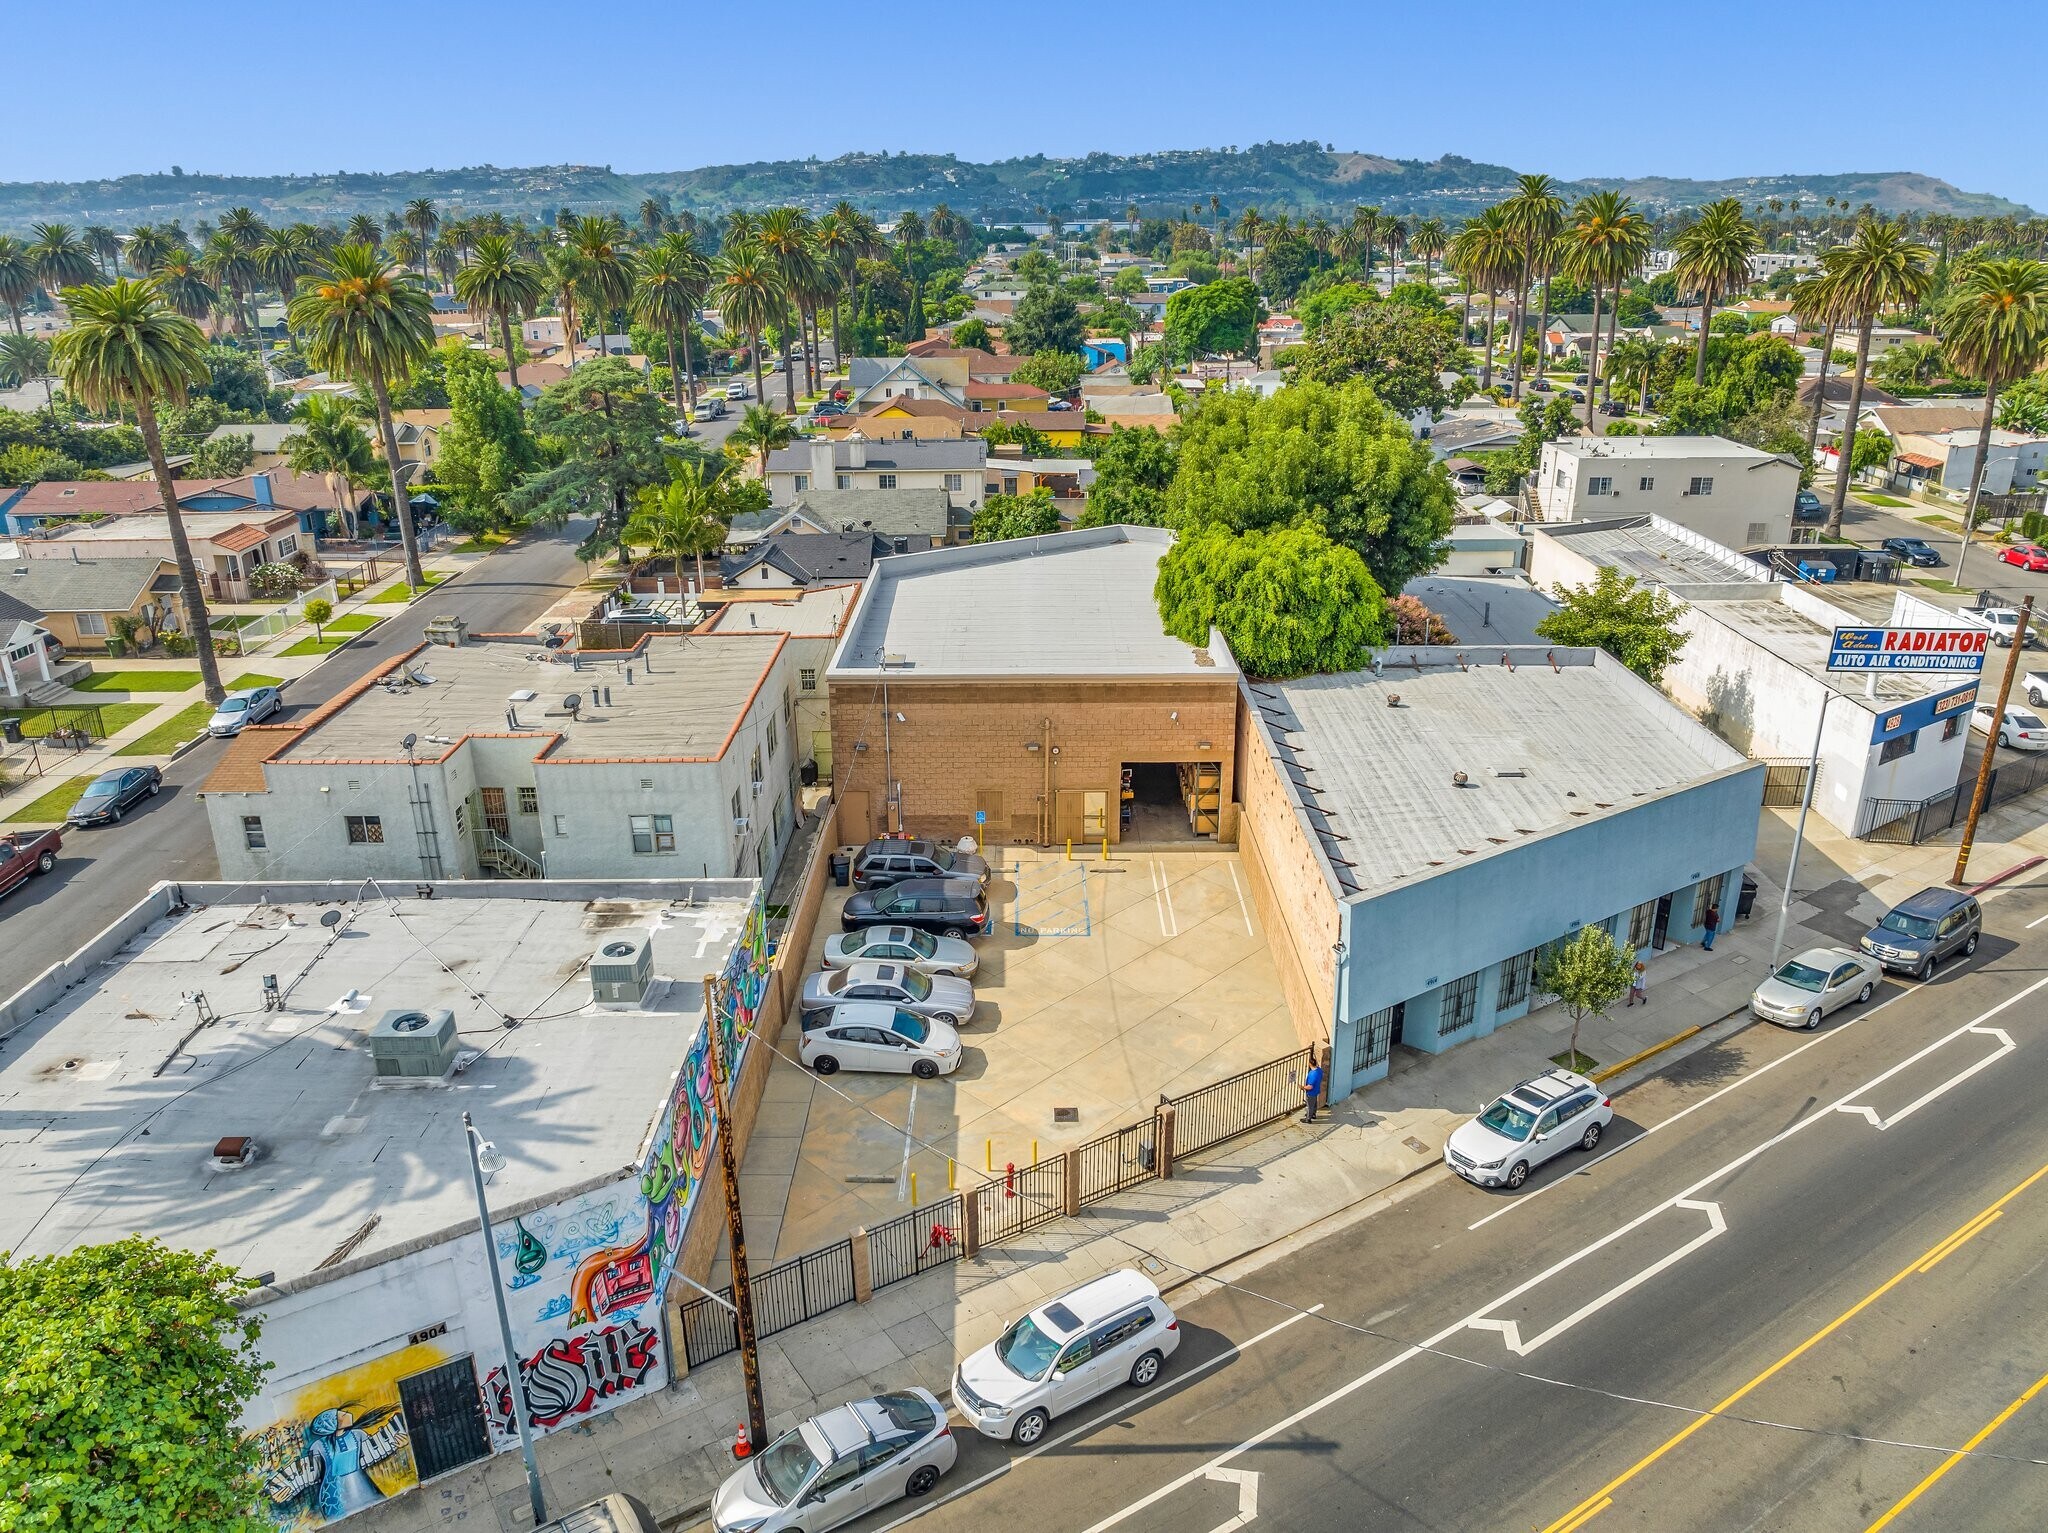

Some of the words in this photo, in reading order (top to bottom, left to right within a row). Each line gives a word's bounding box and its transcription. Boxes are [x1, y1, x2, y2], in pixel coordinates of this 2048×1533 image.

[1839, 632, 1868, 641] West
[1884, 632, 1987, 652] RADIATOR
[1842, 641, 1879, 650] Adams
[1834, 654, 1866, 667] AUTO
[1869, 655, 1891, 667] AIR
[1894, 655, 1977, 669] CONDITIONING
[410, 1324, 447, 1345] 4904
